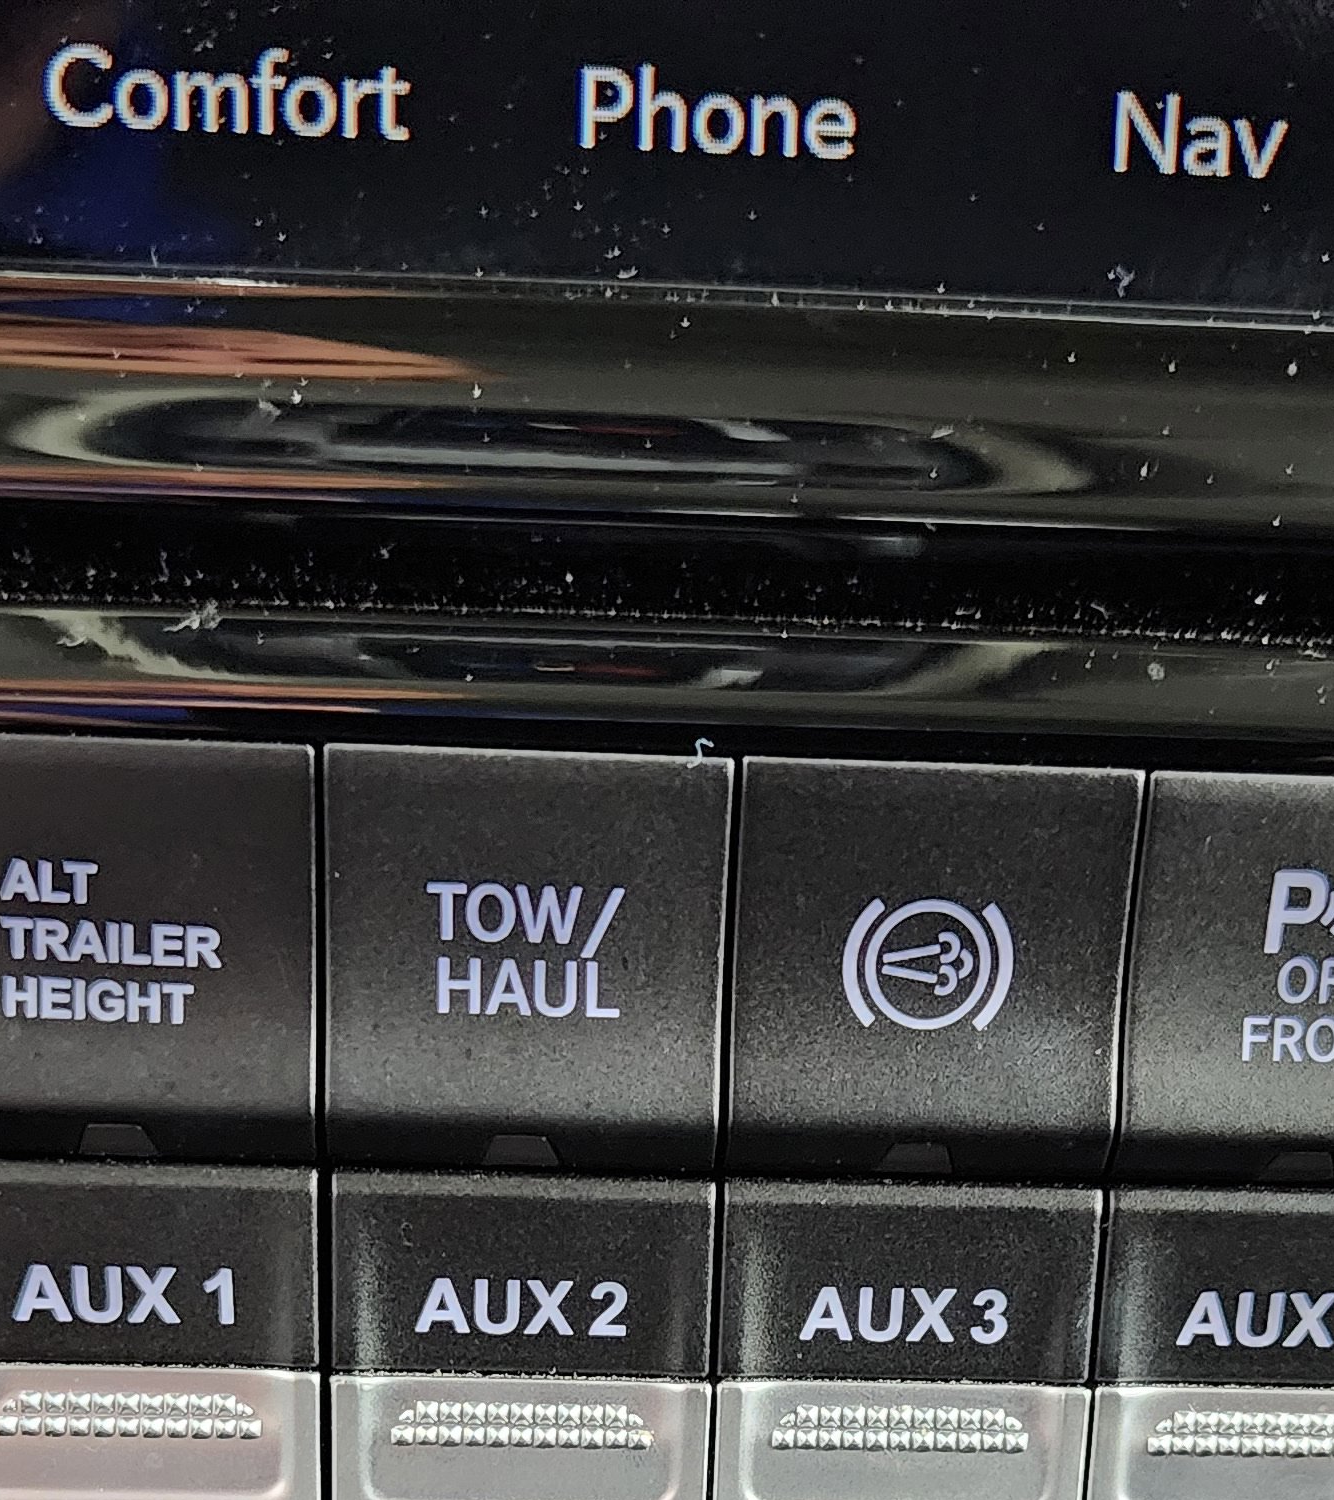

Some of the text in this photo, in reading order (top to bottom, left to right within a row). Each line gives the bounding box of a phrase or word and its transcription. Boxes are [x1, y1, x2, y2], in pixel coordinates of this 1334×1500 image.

[47, 44, 410, 140] Comfort
[580, 65, 855, 159] Phone
[1114, 92, 1288, 178] Nav
[0, 860, 98, 904] ALT
[0, 917, 221, 968] TRAILER
[427, 884, 624, 965] TOW/
[3, 976, 194, 1024] HEIGHT
[438, 957, 620, 1018] HAUL
[13, 1265, 234, 1324] AUX 1
[589, 1282, 627, 1336] 2
[970, 1289, 1008, 1344] 3
